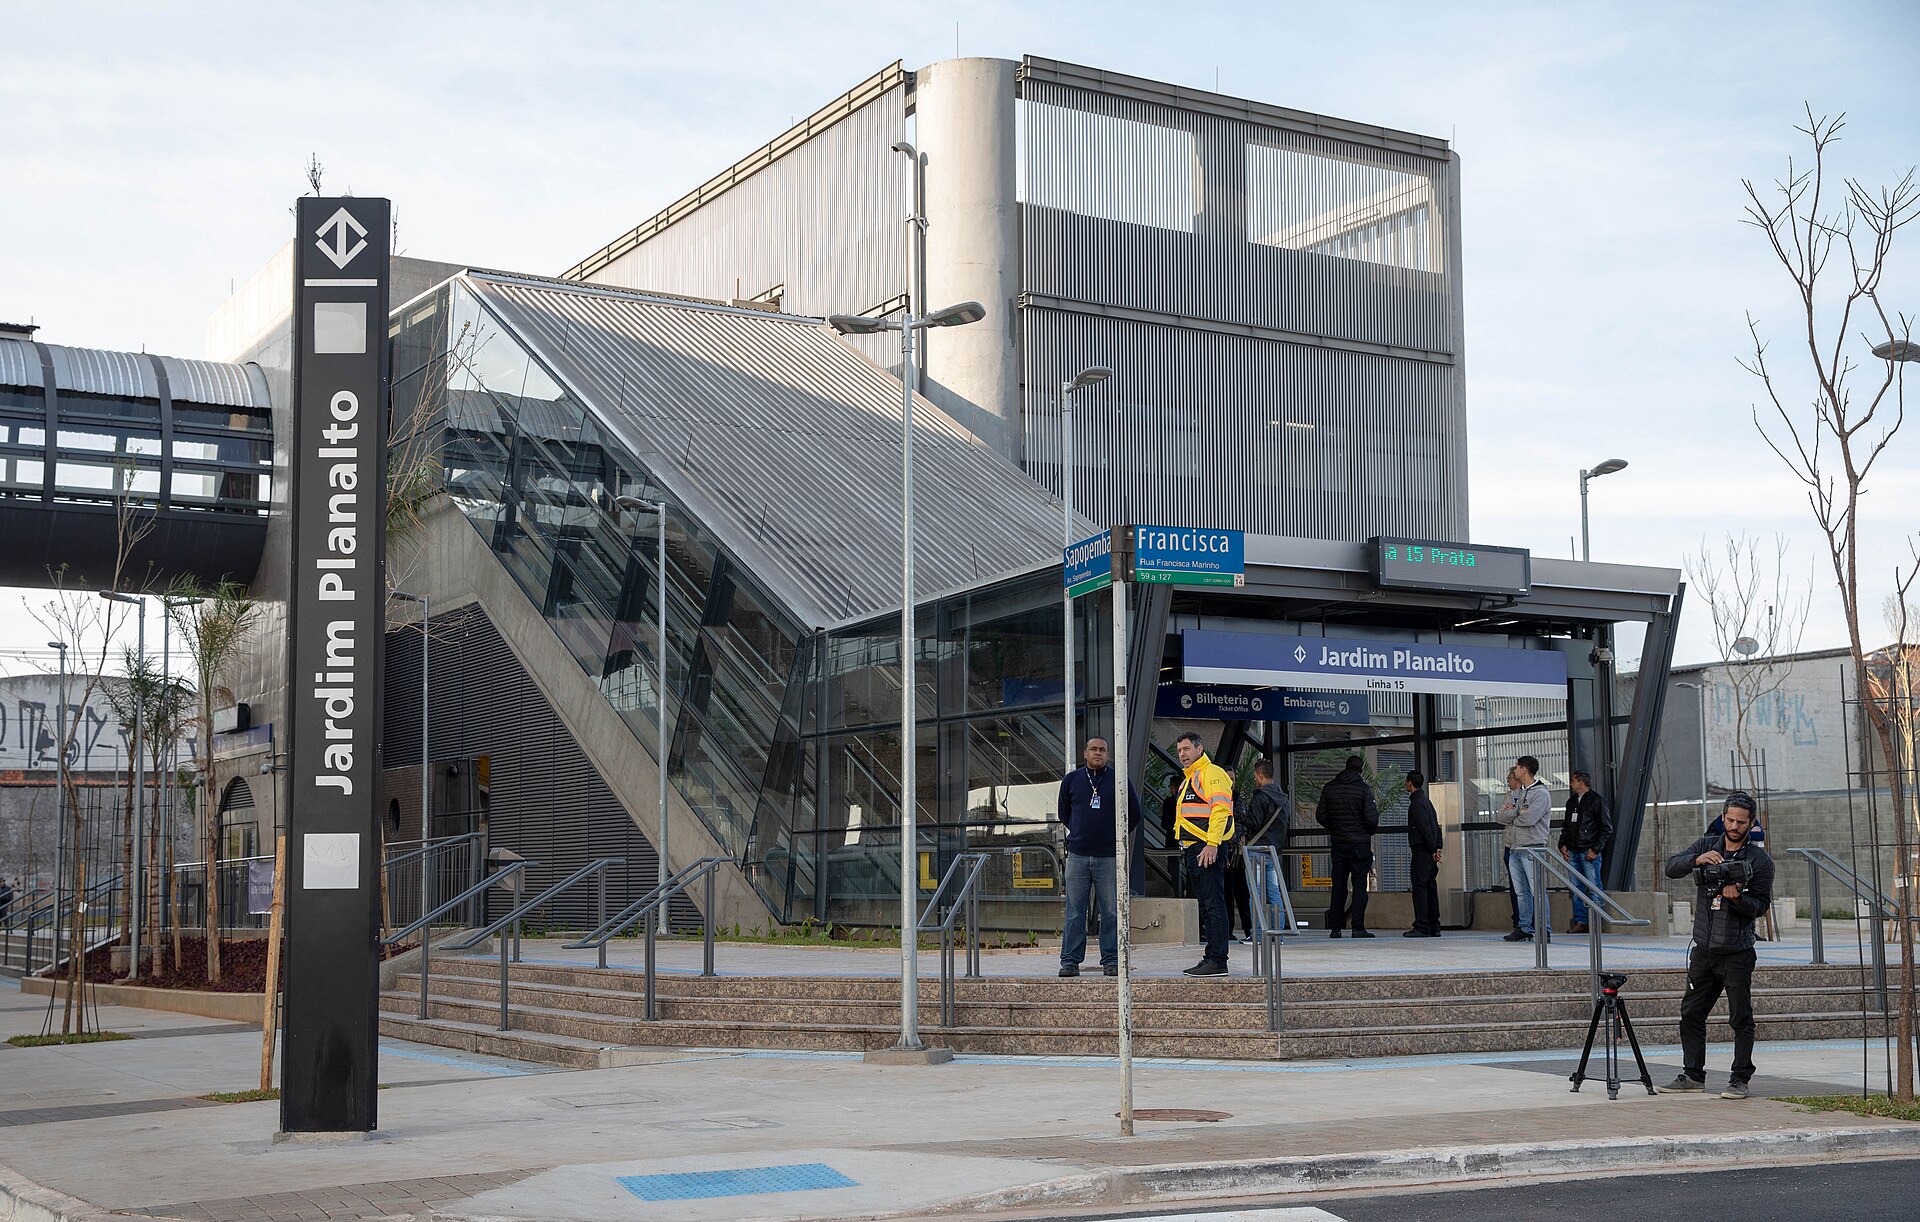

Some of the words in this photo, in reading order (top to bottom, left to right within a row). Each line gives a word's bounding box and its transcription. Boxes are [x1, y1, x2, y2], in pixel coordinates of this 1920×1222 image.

[316, 390, 359, 601] Planalto
[1138, 528, 1229, 553] Francisca
[1065, 533, 1111, 570] Sapopemba
[1406, 546, 1423, 562] 15
[1431, 548, 1475, 567] Prata
[1140, 558, 1154, 566] Rua
[1156, 558, 1190, 568] Francisca
[1191, 560, 1220, 569] Marinho
[1140, 572, 1150, 580] 59
[1159, 573, 1172, 581] 127
[1319, 646, 1388, 669] Jardim
[1393, 650, 1475, 673] Planalto
[1366, 679, 1391, 689] Linha
[1395, 680, 1404, 689] 15
[1196, 693, 1249, 705] Bilheteria
[1283, 696, 1336, 710] Embarque
[314, 620, 355, 796] Jardim
[1233, 705, 1249, 713] Office
